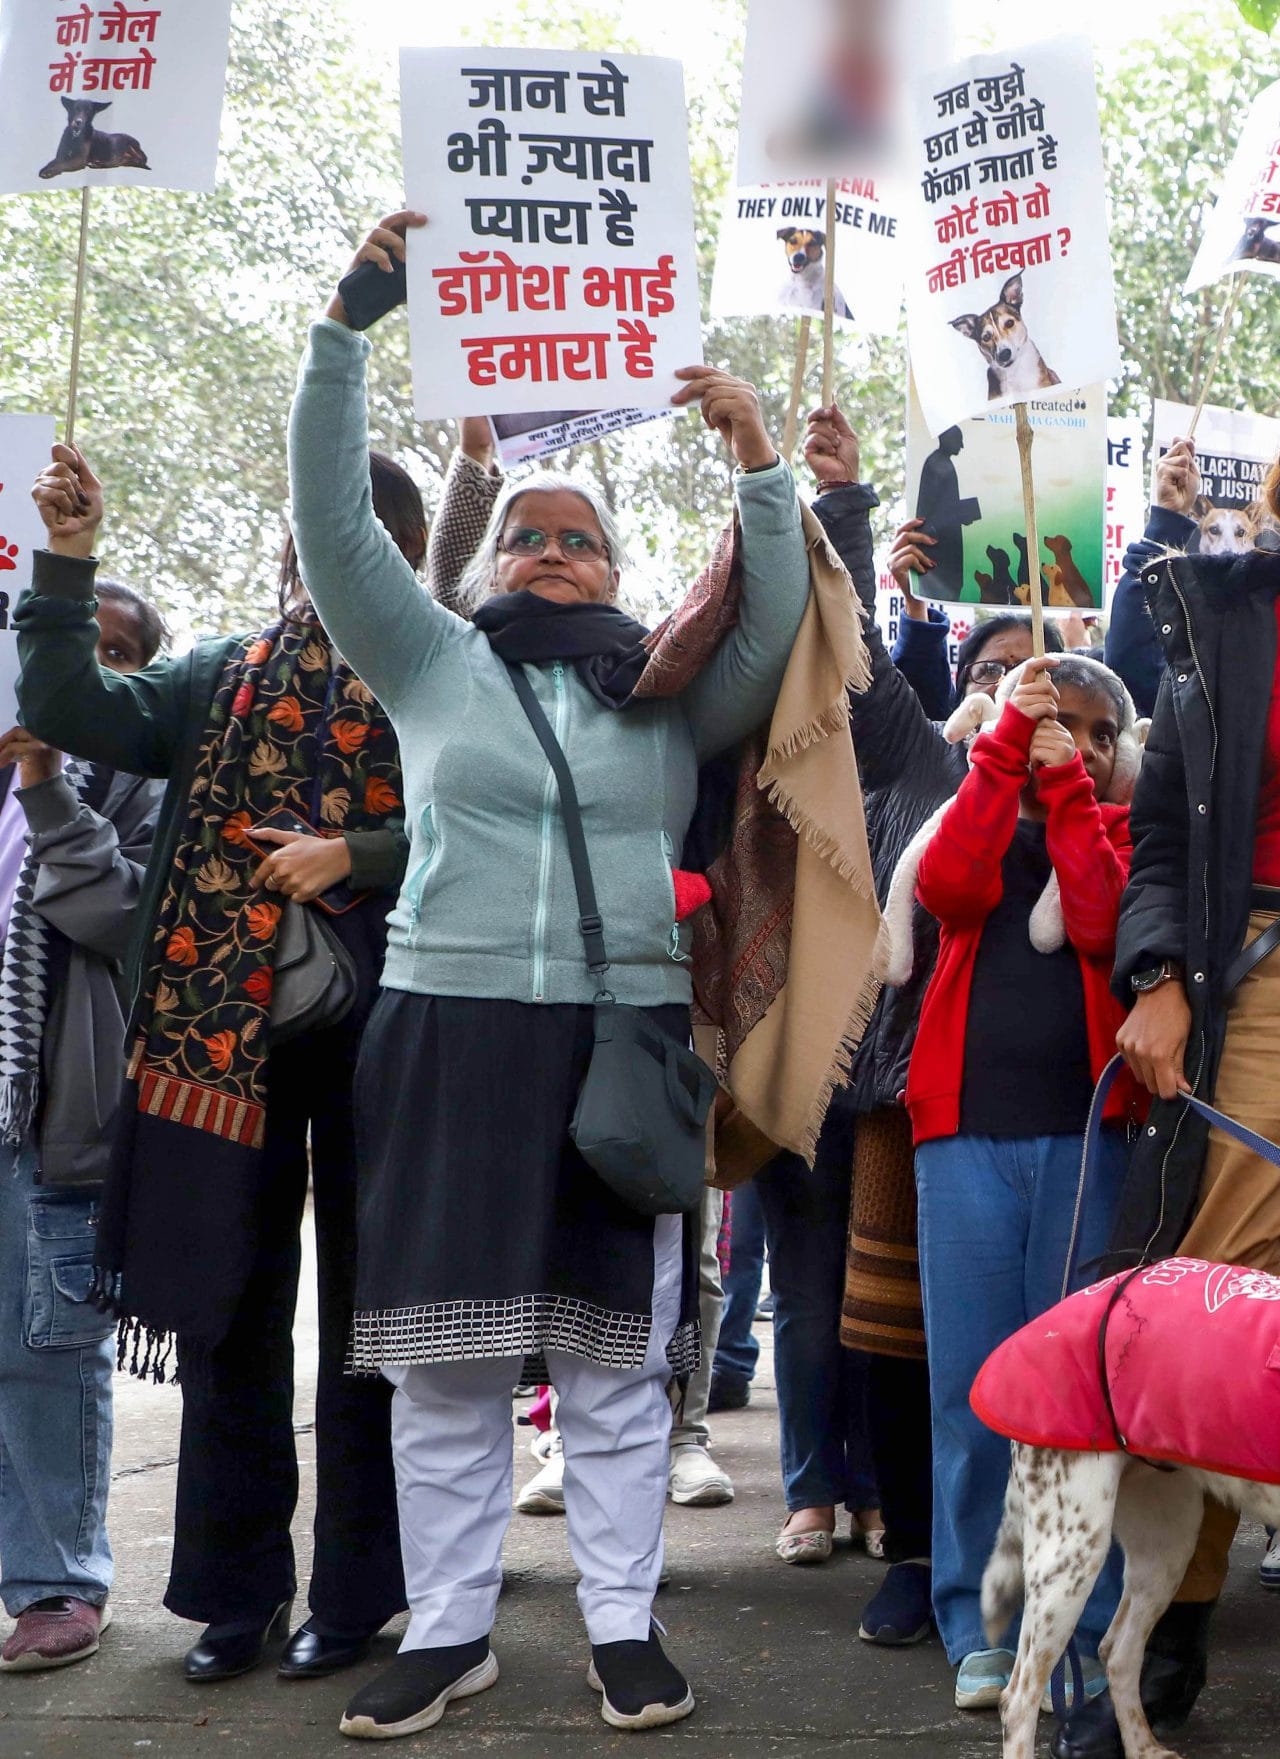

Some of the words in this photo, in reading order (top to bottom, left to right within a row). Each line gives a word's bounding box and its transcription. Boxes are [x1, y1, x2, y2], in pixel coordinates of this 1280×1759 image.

[56, 4, 94, 46] को
[98, 1, 161, 43] जेल
[49, 52, 81, 93] में
[82, 48, 156, 90] डालो
[461, 69, 570, 113] जान
[577, 60, 629, 117] से
[934, 82, 970, 117] जब
[974, 63, 1025, 113] मुझे
[447, 118, 511, 176] भी
[519, 134, 653, 185] ज़्यादा
[924, 127, 959, 162] छत
[962, 111, 988, 147] से
[992, 98, 1045, 139] नीचे
[921, 163, 971, 203] फेंका
[974, 148, 1034, 183] जाता
[1037, 135, 1058, 170] है
[465, 199, 592, 245] प्यारा
[599, 188, 637, 246] है
[738, 198, 776, 218] THEY
[782, 197, 825, 218] ONLY
[835, 203, 863, 229] SEE
[868, 212, 897, 238] ME
[935, 196, 979, 243] कोर्ट
[982, 191, 1019, 226] को
[1023, 182, 1050, 218] वो
[432, 251, 570, 316] डॉगेश
[583, 255, 676, 317] भाई
[926, 247, 969, 293] नहीं
[970, 234, 1051, 278] दिखता
[461, 334, 610, 386] हमारा
[617, 319, 657, 378] है
[987, 414, 1044, 426] MAHMA
[1045, 417, 1087, 428] GANDHI
